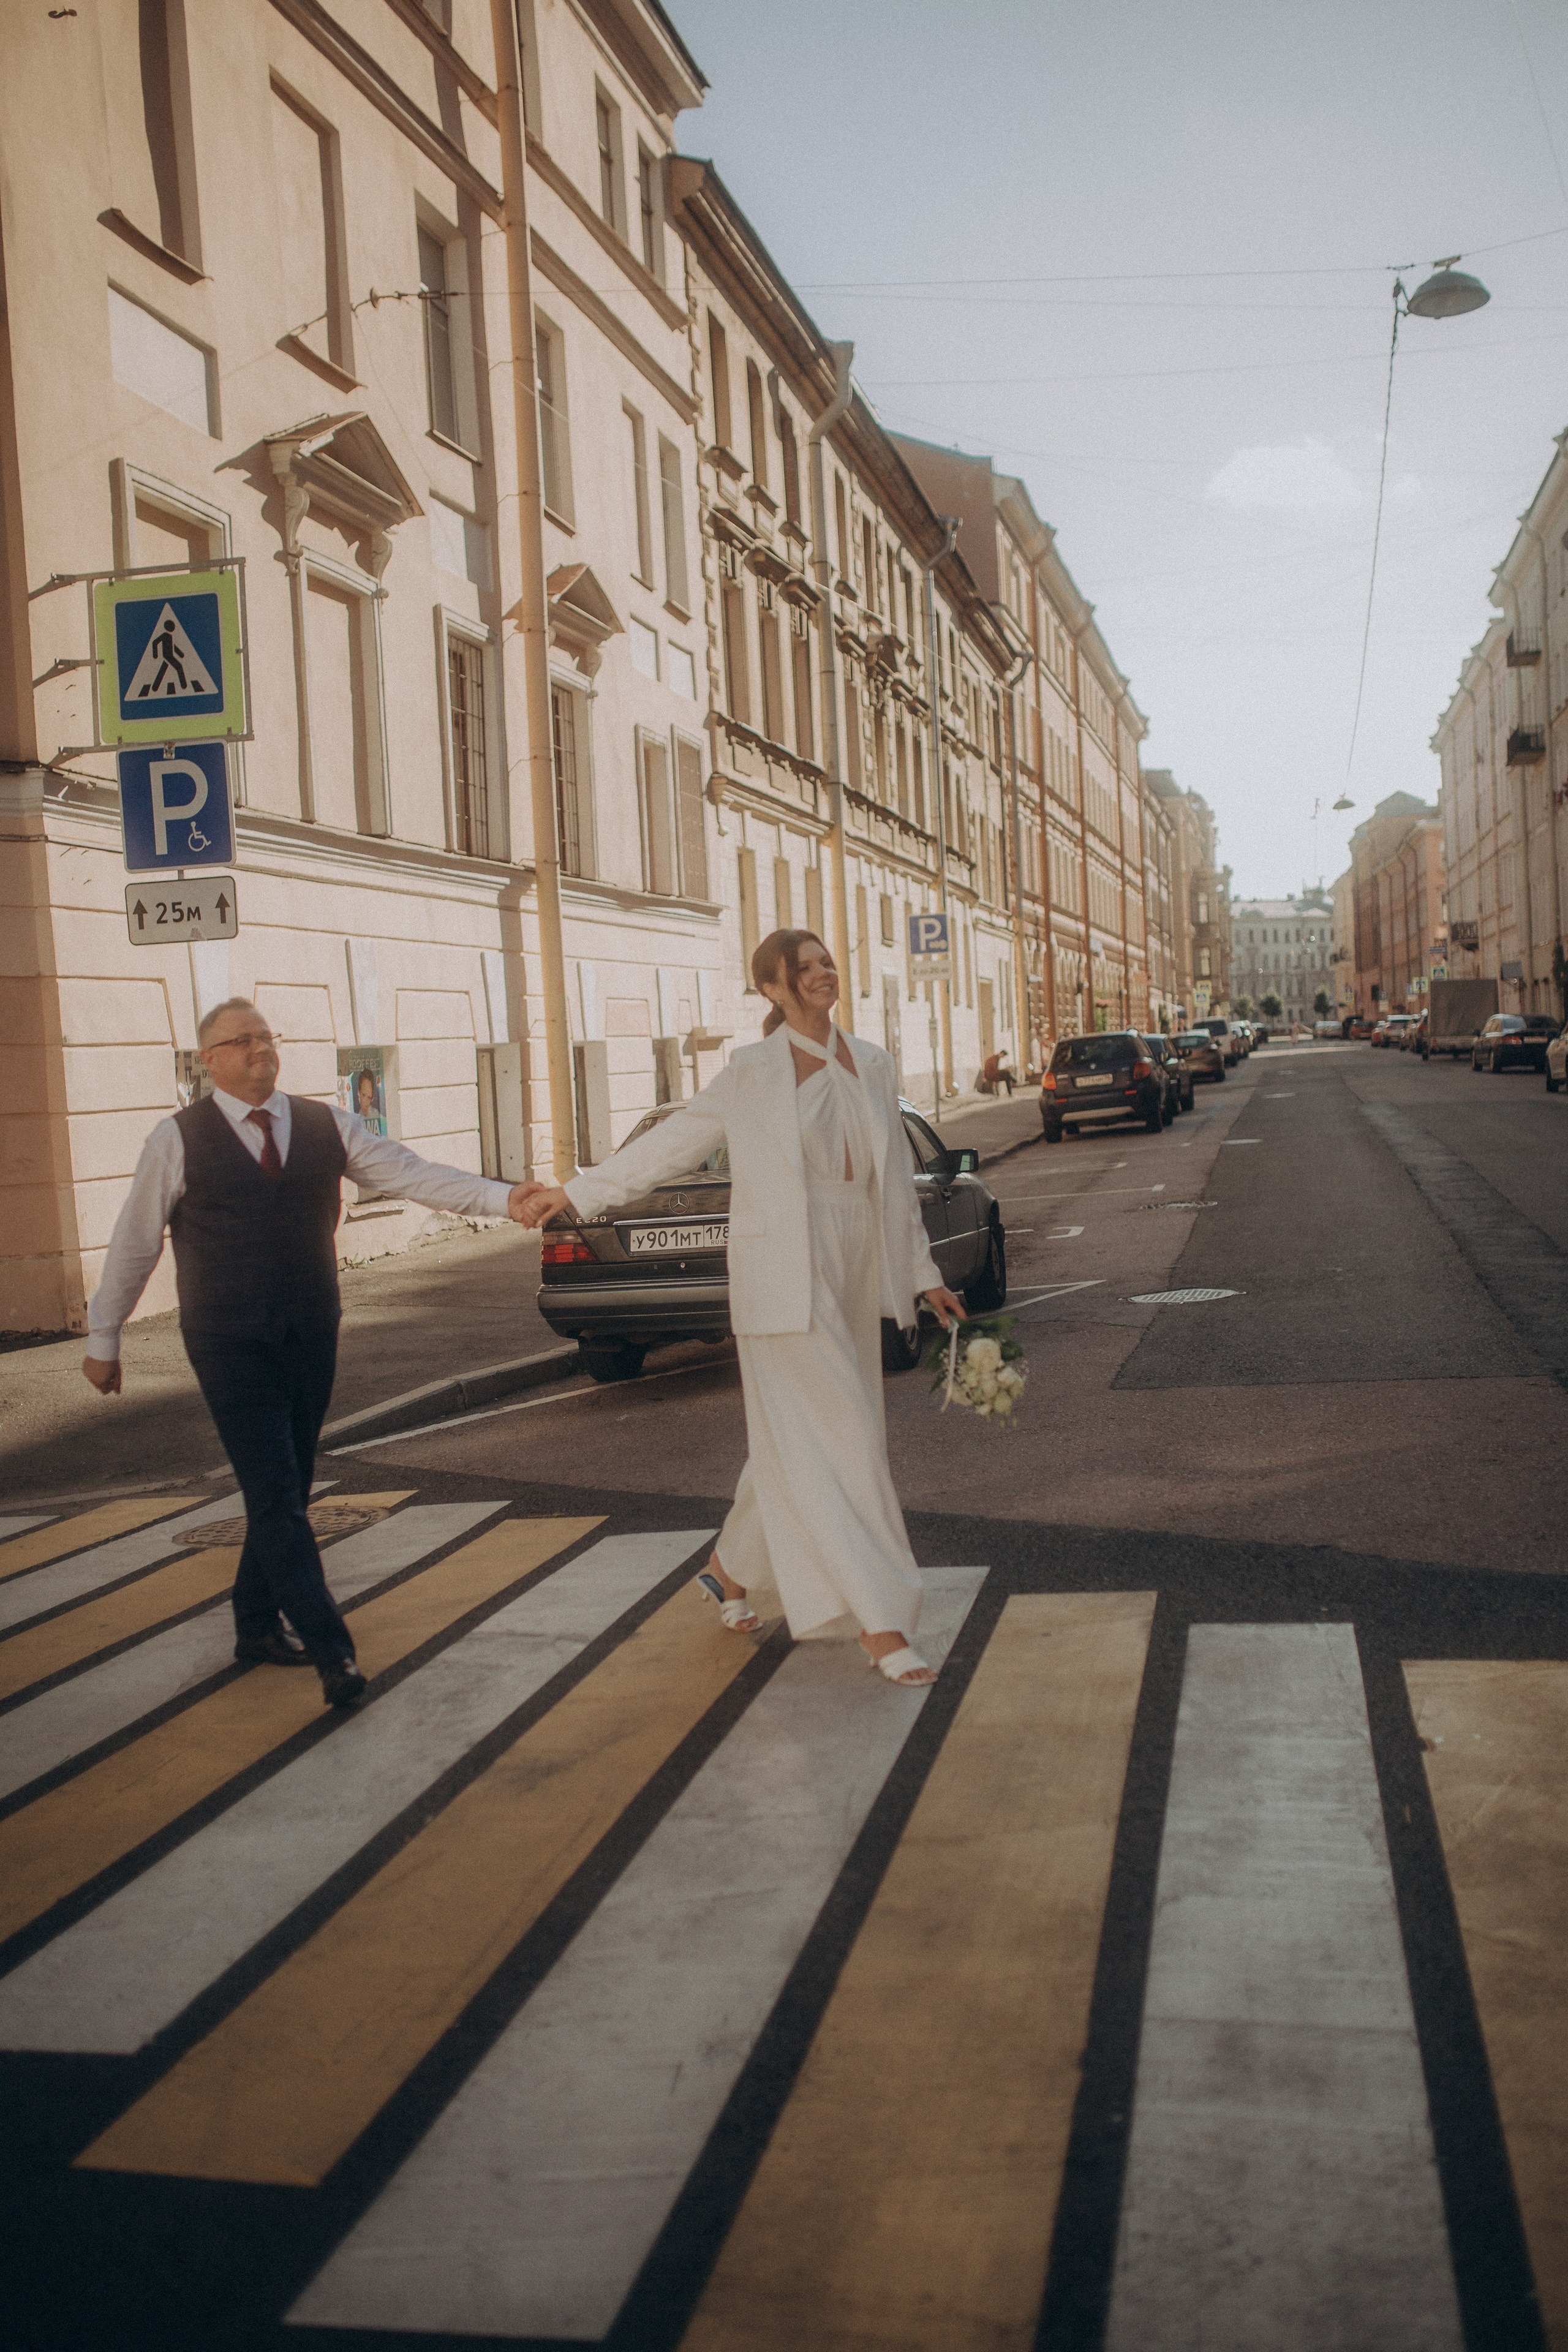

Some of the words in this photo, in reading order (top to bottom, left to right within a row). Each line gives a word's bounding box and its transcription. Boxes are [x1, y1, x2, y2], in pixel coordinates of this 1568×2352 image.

[149, 759, 208, 856] P
[919, 918, 941, 951] P
[706, 1226, 729, 1240] 178
